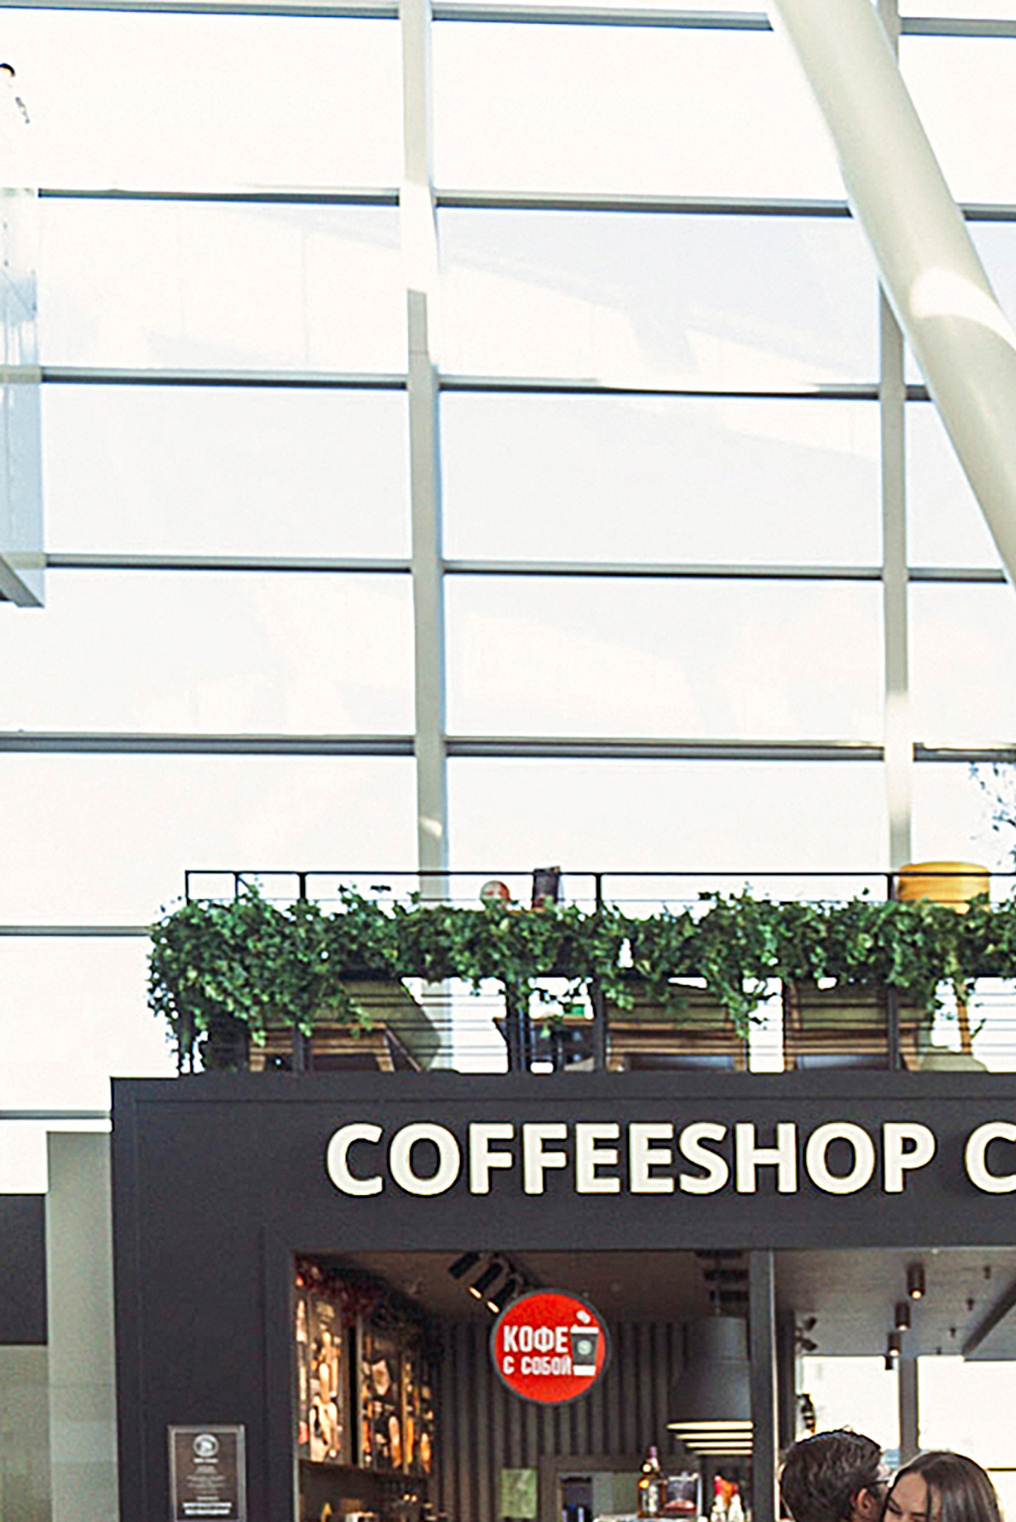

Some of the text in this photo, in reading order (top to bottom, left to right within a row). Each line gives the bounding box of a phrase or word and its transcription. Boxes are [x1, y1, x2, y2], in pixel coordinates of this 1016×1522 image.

[326, 1122, 936, 1197] COFFEESHOP
[503, 1325, 569, 1353] КОФЕ
[503, 1355, 515, 1375] С
